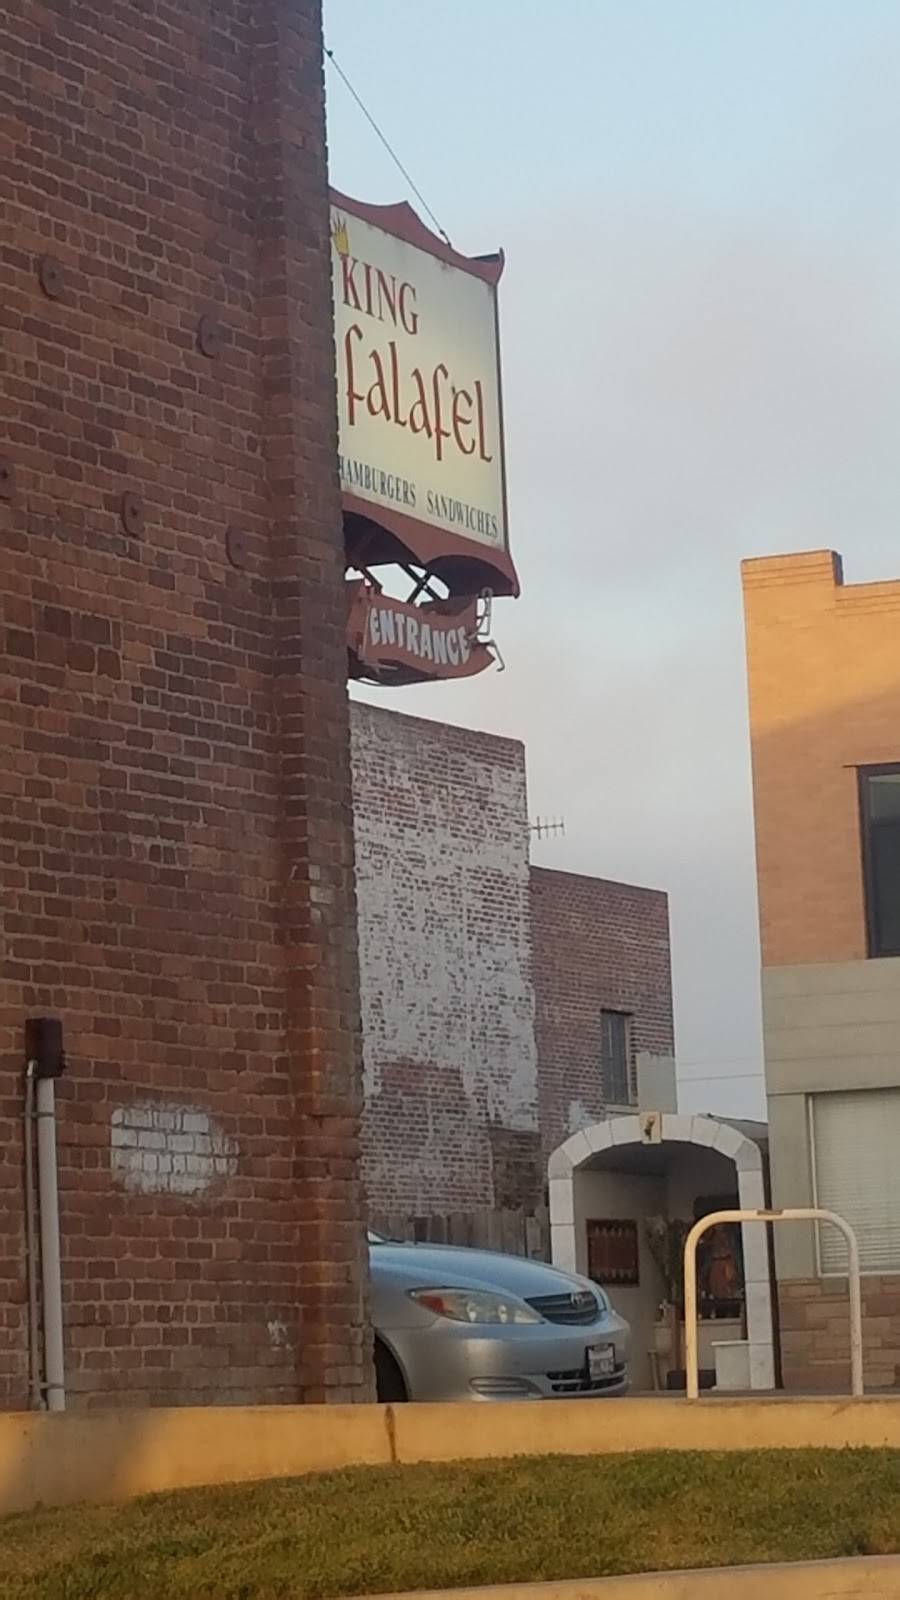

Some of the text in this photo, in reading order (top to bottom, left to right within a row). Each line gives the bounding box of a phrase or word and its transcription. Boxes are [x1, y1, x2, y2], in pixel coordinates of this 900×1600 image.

[341, 255, 418, 335] KING
[338, 455, 498, 538] HAMBURGERS SANDWICHES
[369, 607, 471, 666] ENTRANCE
